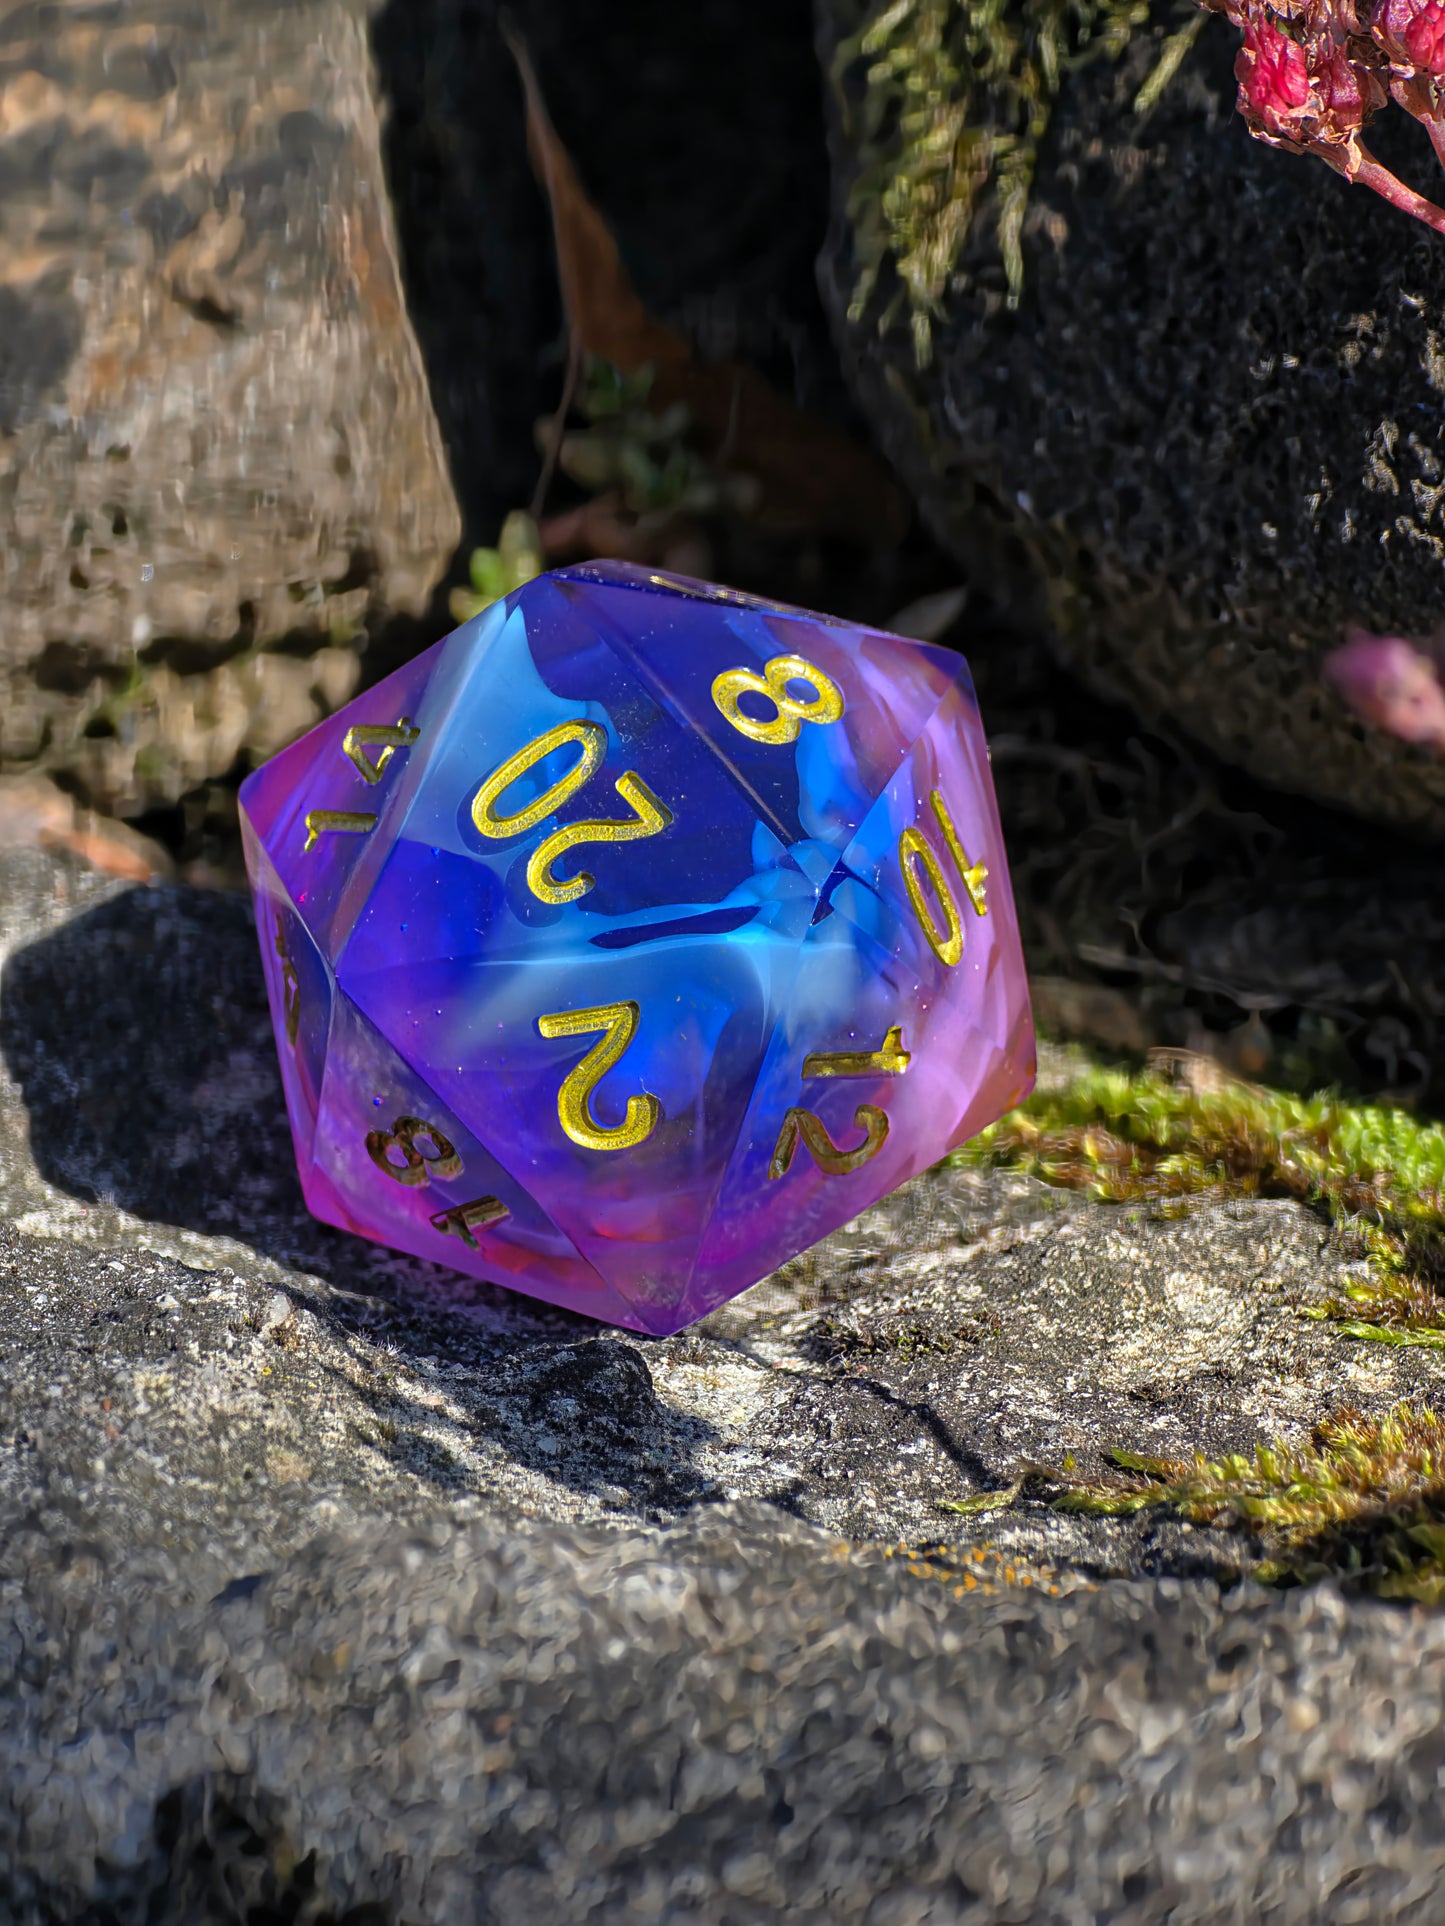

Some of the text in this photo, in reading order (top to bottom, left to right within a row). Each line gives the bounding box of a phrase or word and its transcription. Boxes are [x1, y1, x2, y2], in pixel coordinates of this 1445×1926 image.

[711, 656, 845, 745] 8
[304, 717, 421, 852] 14
[471, 718, 674, 905] 20
[899, 789, 988, 967] 10
[538, 1000, 661, 1151] 2
[767, 1025, 911, 1180] 12
[364, 1115, 511, 1251] 18
